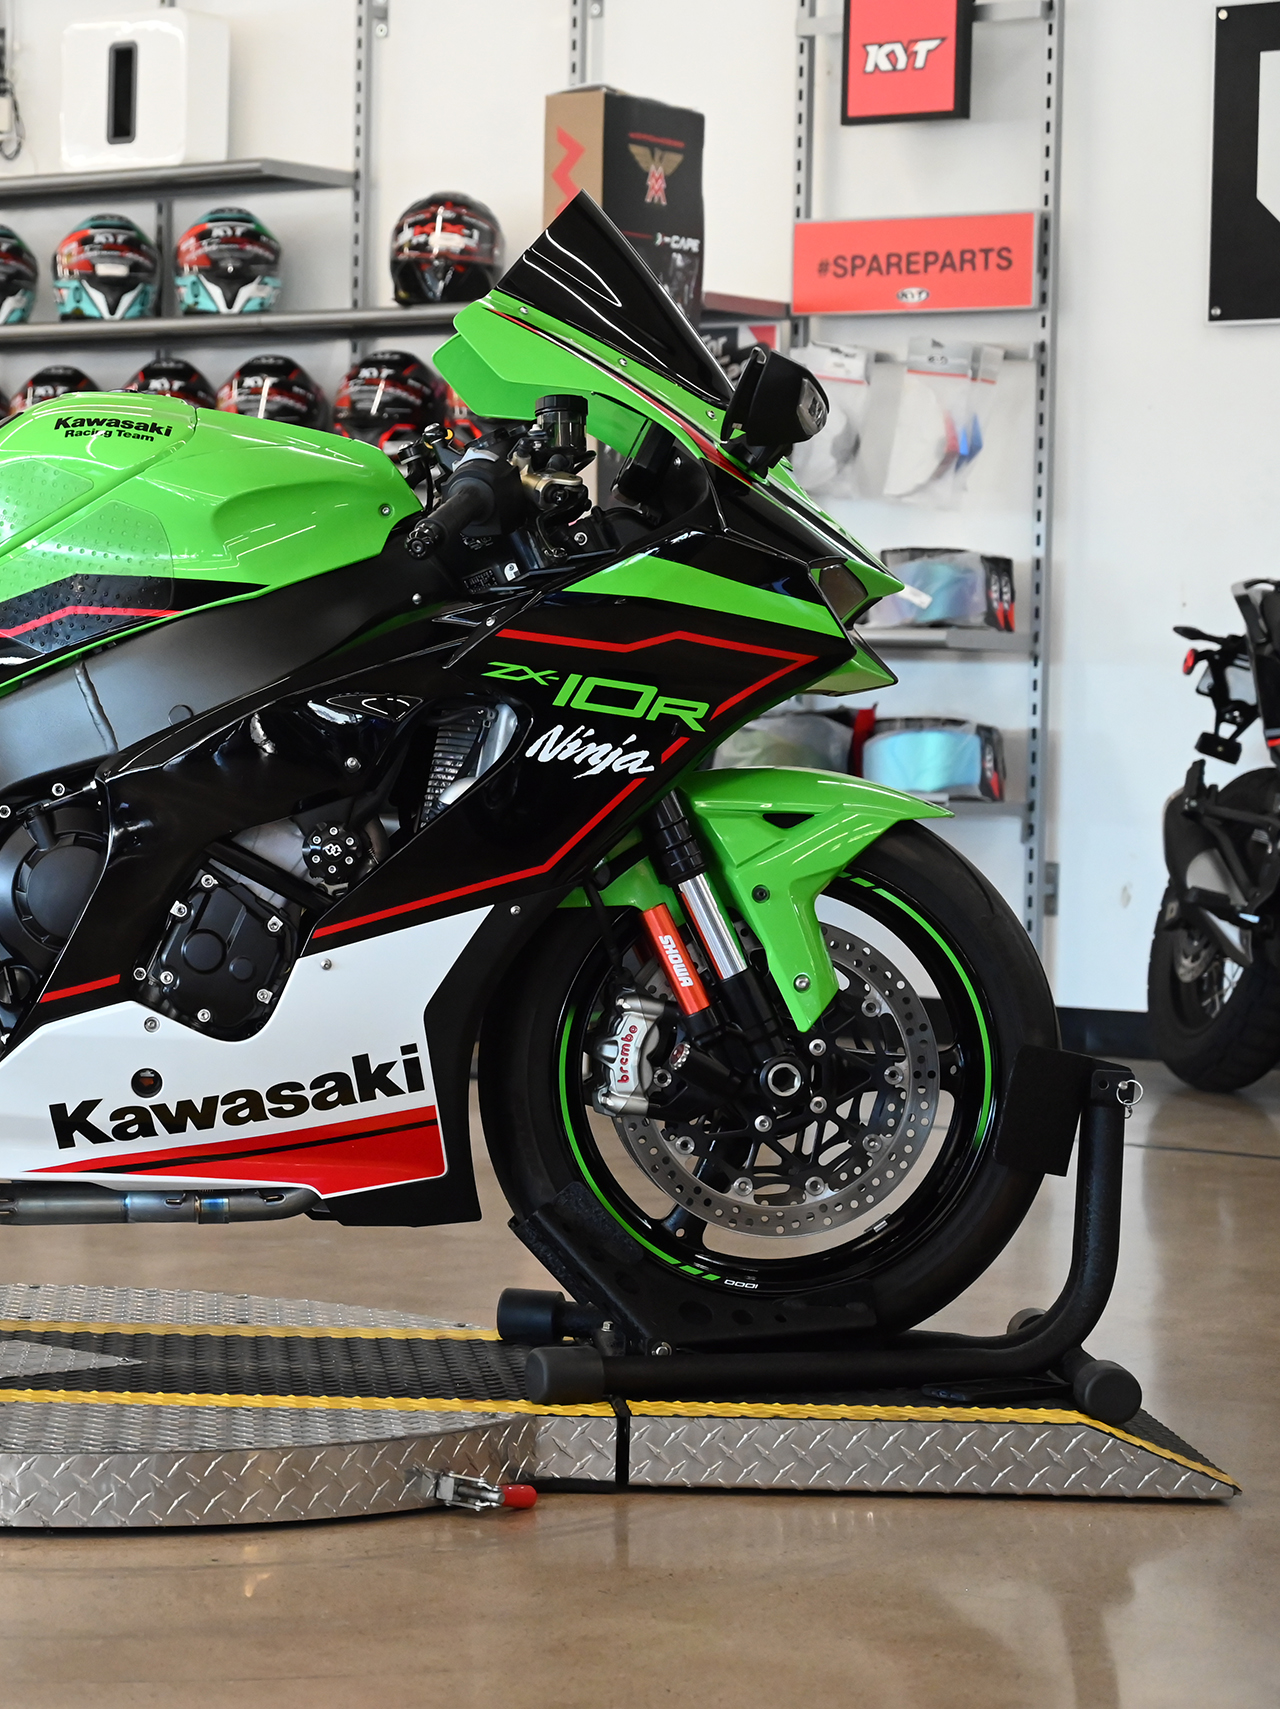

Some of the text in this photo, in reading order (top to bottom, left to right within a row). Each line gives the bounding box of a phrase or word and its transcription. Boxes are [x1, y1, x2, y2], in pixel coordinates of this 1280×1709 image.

[863, 36, 947, 74] KYT
[817, 247, 1013, 278] #SPAREPARTS
[54, 416, 173, 437] Kawasaki
[64, 428, 155, 442] Racing Team
[480, 661, 710, 732] ZX-10R
[525, 724, 655, 780] Ninja
[658, 934, 694, 988] SHOWA
[616, 1024, 638, 1084] brembo
[48, 1042, 425, 1150] Kawasaki
